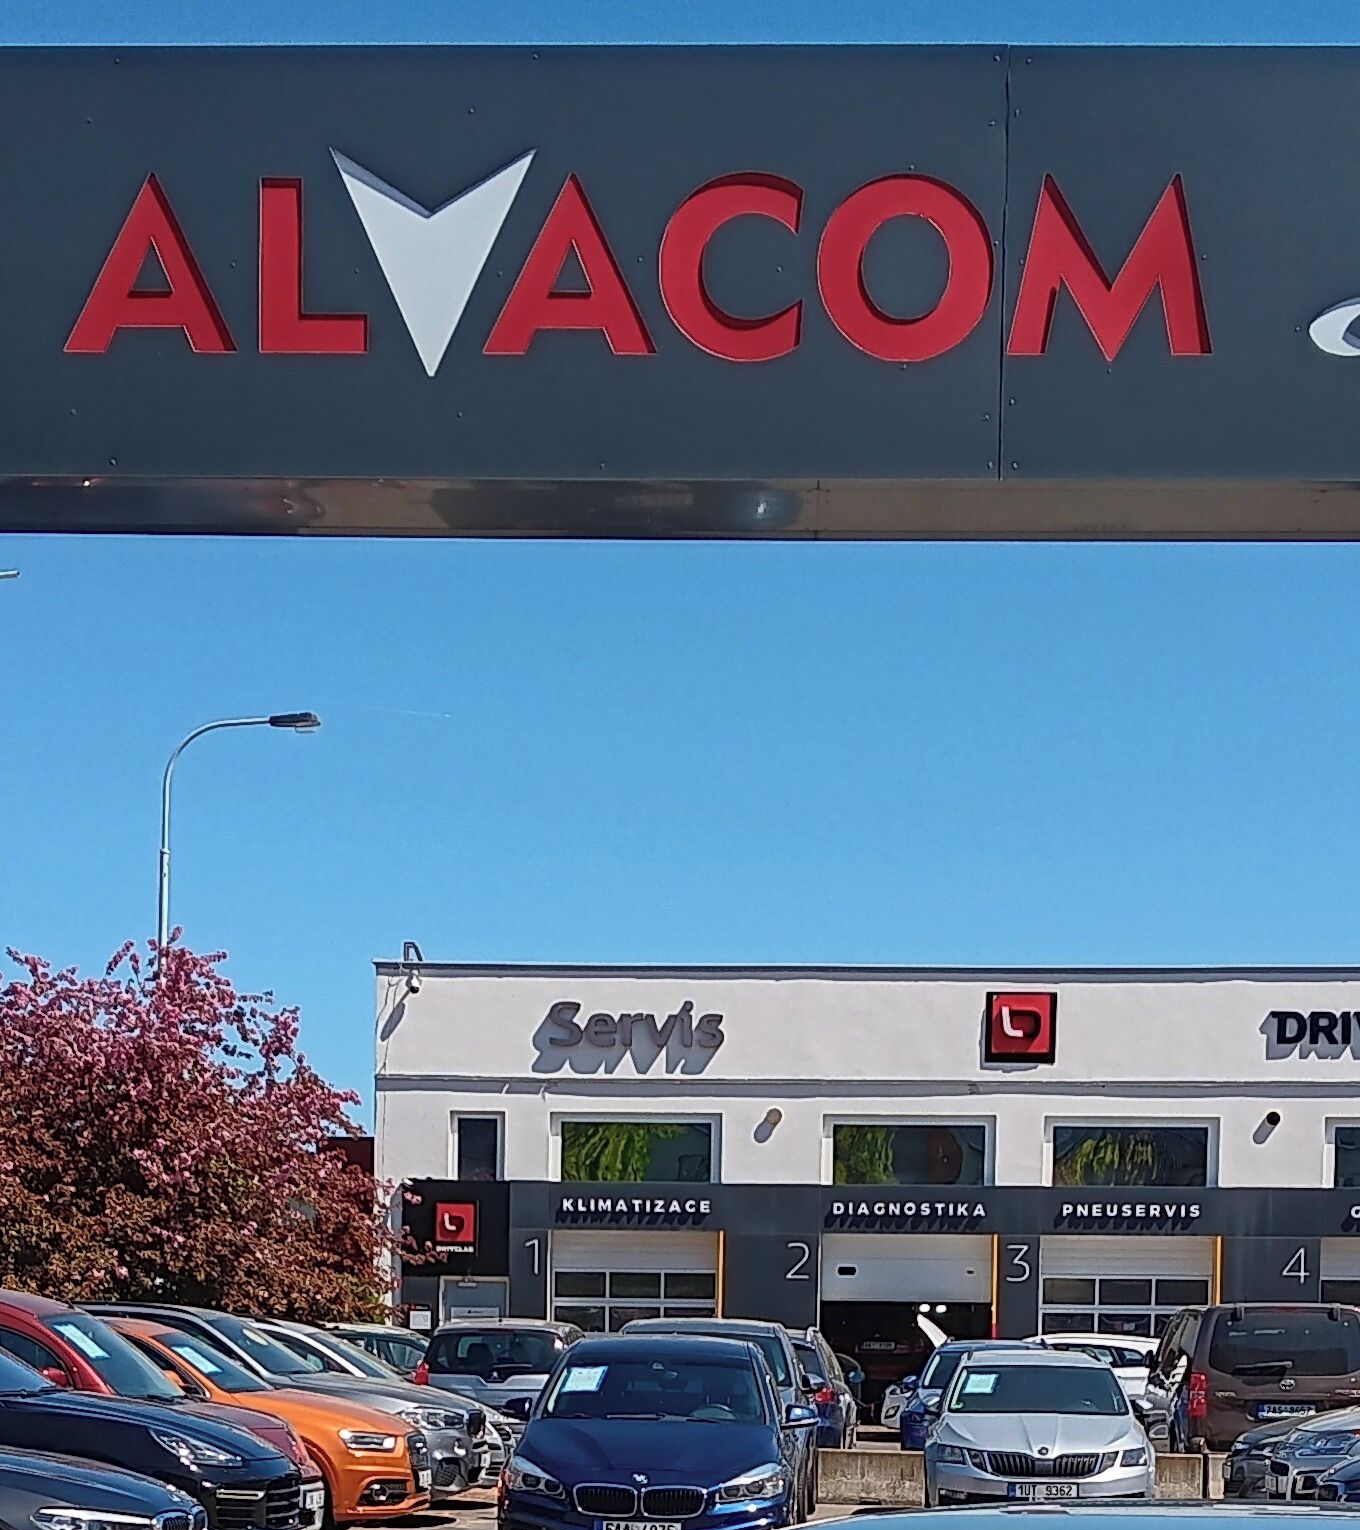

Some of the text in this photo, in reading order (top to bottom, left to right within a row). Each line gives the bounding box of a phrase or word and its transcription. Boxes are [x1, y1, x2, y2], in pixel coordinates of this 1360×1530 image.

[63, 147, 1212, 377] ALVACOM
[547, 1001, 725, 1048] Servis
[562, 1198, 711, 1214] KLIMATIZACE
[832, 1202, 986, 1217] DIAGNOSTIKA
[1062, 1204, 1201, 1218] PNEUSERVIS
[524, 1238, 539, 1275] 1
[785, 1242, 811, 1280] 2
[1005, 1244, 1031, 1282] 3
[1281, 1247, 1311, 1285] 4
